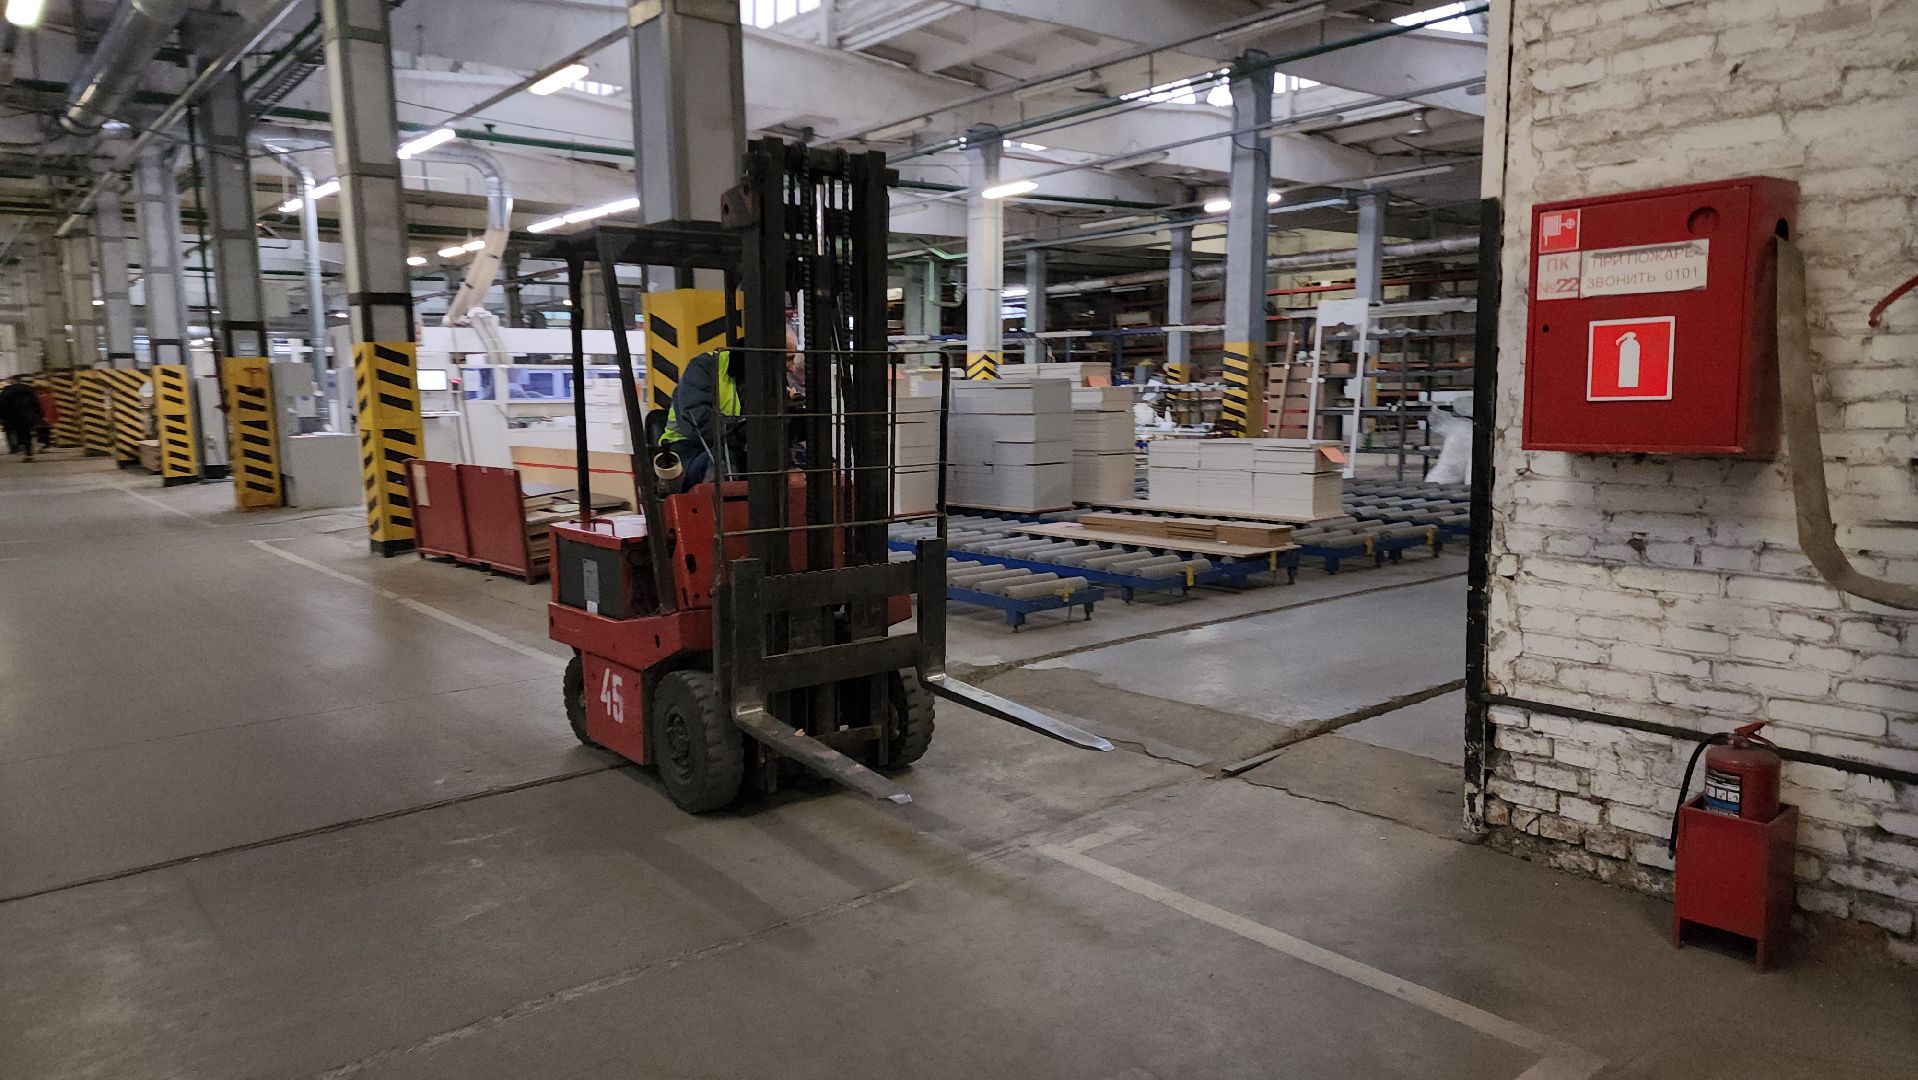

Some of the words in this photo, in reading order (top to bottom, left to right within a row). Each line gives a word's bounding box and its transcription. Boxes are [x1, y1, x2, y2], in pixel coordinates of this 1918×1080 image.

[1547, 257, 1570, 272] ПК
[1593, 254, 1623, 269] ПРИ
[1626, 247, 1694, 266] ПОЖАРЕ
[1587, 272, 1656, 290] ЗВОНИТЬ
[1665, 266, 1698, 281] 0101
[600, 668, 625, 724] 45
